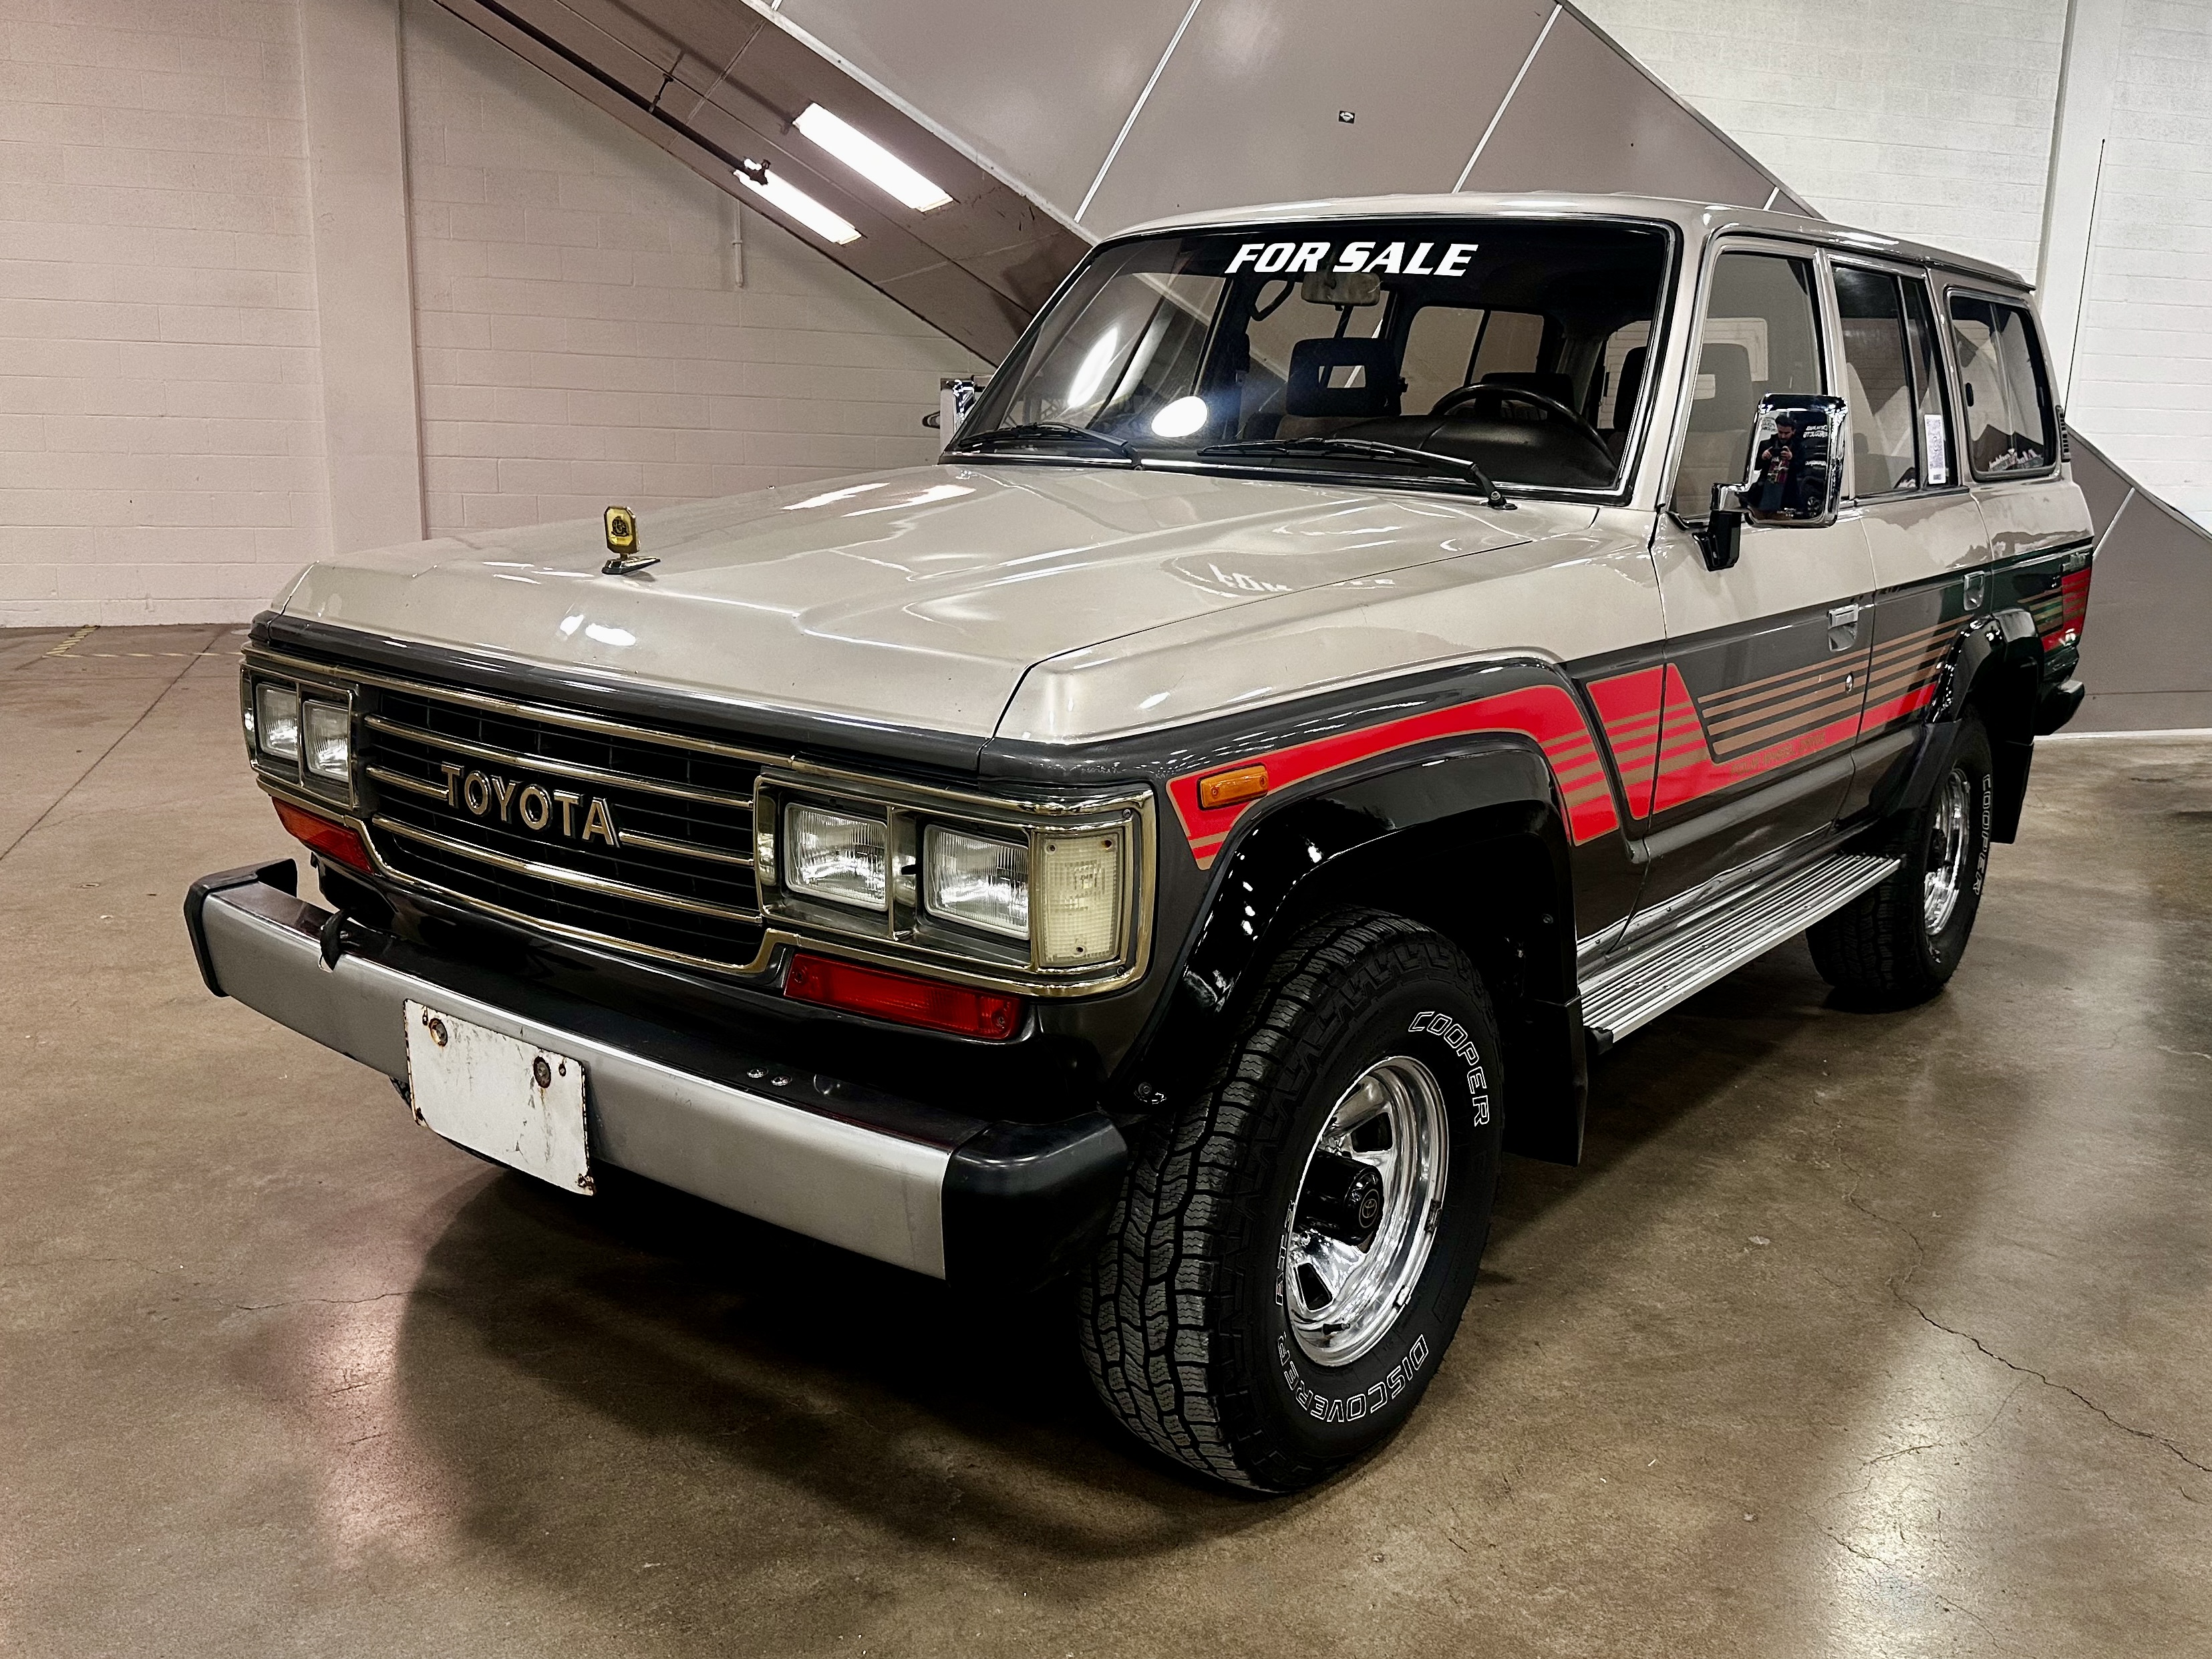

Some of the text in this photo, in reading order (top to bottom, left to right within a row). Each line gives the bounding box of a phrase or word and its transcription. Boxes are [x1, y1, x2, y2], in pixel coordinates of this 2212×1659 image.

[1224, 241, 1478, 277] FOR SALE
[441, 760, 621, 849] TOYOTA
[1972, 774, 1992, 896] COOPER
[1408, 1010, 1490, 1127] COOPER
[1277, 1330, 1429, 1422] DISCOVERER
